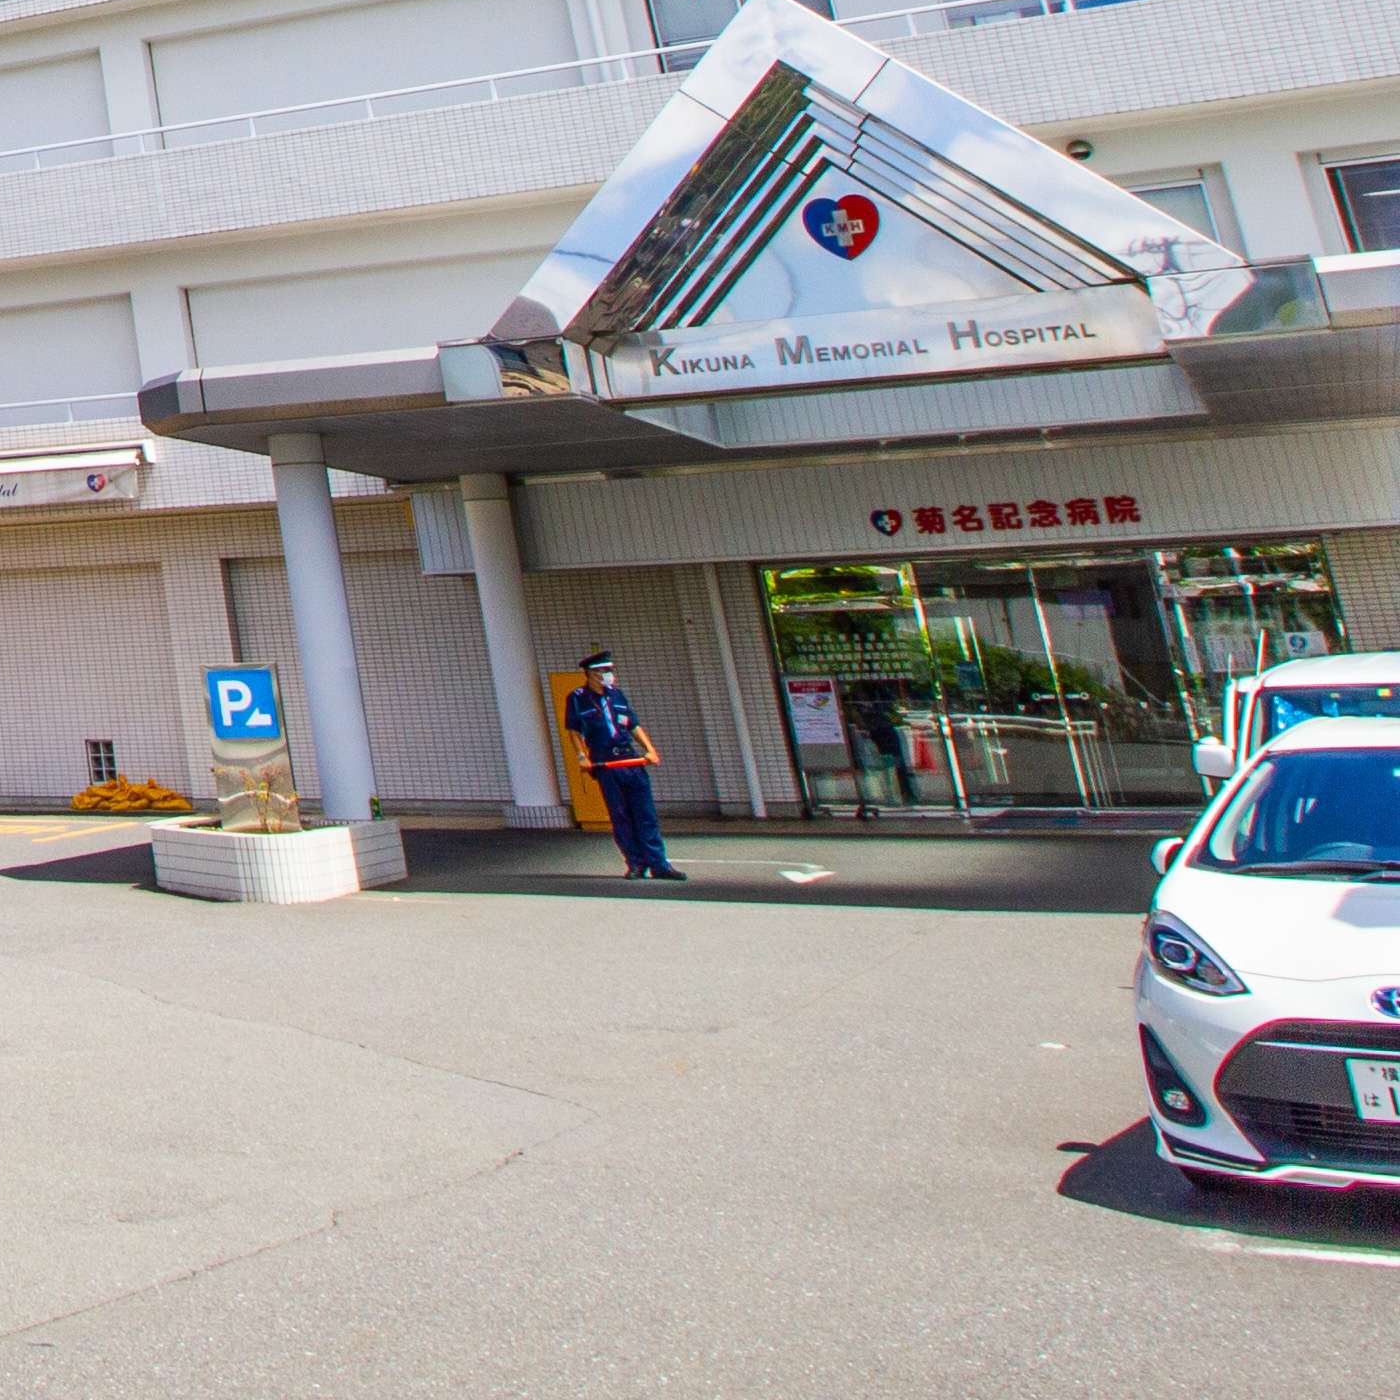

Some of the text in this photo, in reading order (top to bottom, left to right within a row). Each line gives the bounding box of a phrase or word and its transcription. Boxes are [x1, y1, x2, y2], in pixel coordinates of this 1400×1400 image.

[824, 221, 861, 234] KMH
[913, 495, 1141, 536] 菊名記念病院
[218, 680, 253, 727] P
